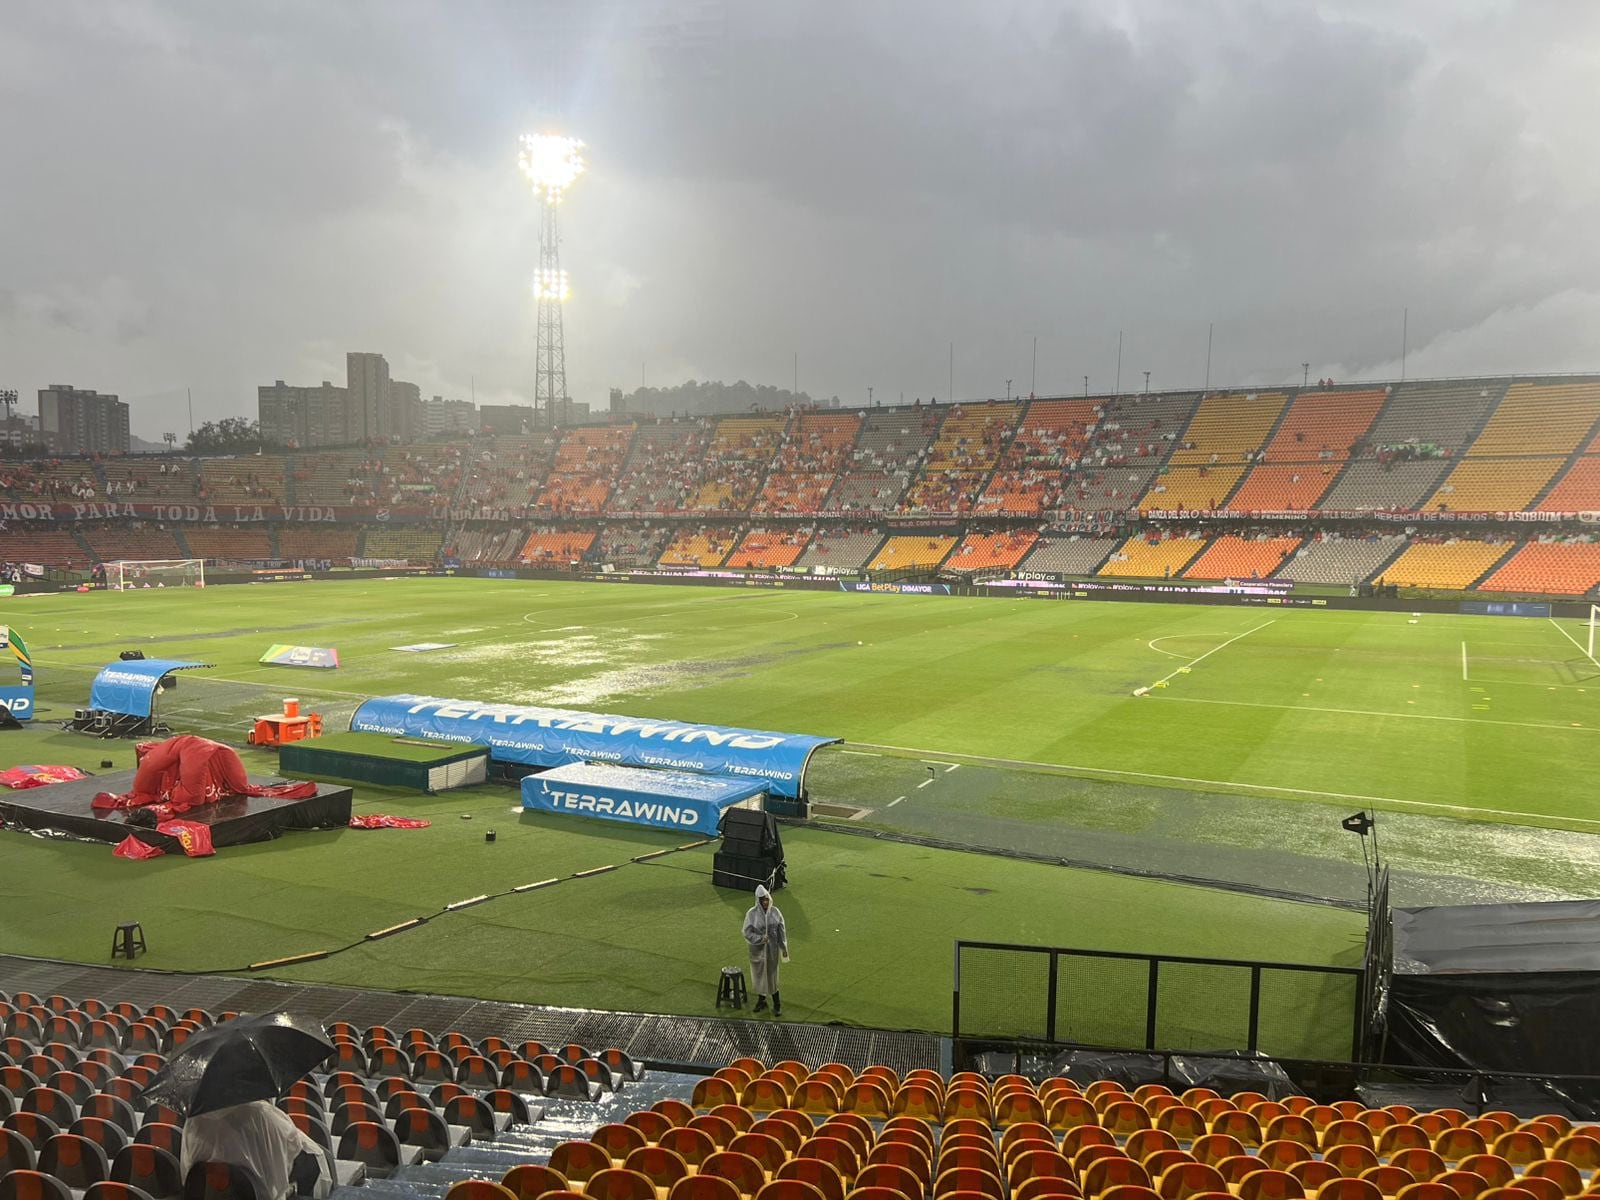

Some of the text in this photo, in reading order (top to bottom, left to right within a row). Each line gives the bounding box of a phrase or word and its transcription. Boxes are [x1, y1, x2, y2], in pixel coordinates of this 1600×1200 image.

[72, 502, 138, 520] PARA
[152, 505, 218, 522] TODA
[233, 506, 265, 522] LA
[281, 506, 336, 522] VIDA
[1374, 511, 1487, 521] HERENCIA DE MIS HIJOS
[1018, 571, 1055, 581] Wplay.co
[871, 583, 901, 593] BetPlay
[359, 723, 405, 735] TERRAWIND
[423, 730, 472, 743] TERRAWIND
[491, 738, 544, 752] TERRAWIND
[564, 746, 621, 761] TERRAWIND
[644, 754, 704, 769] TERRAWIND
[727, 764, 793, 780] TERRAWIND
[549, 791, 699, 825] TERRAWIND
